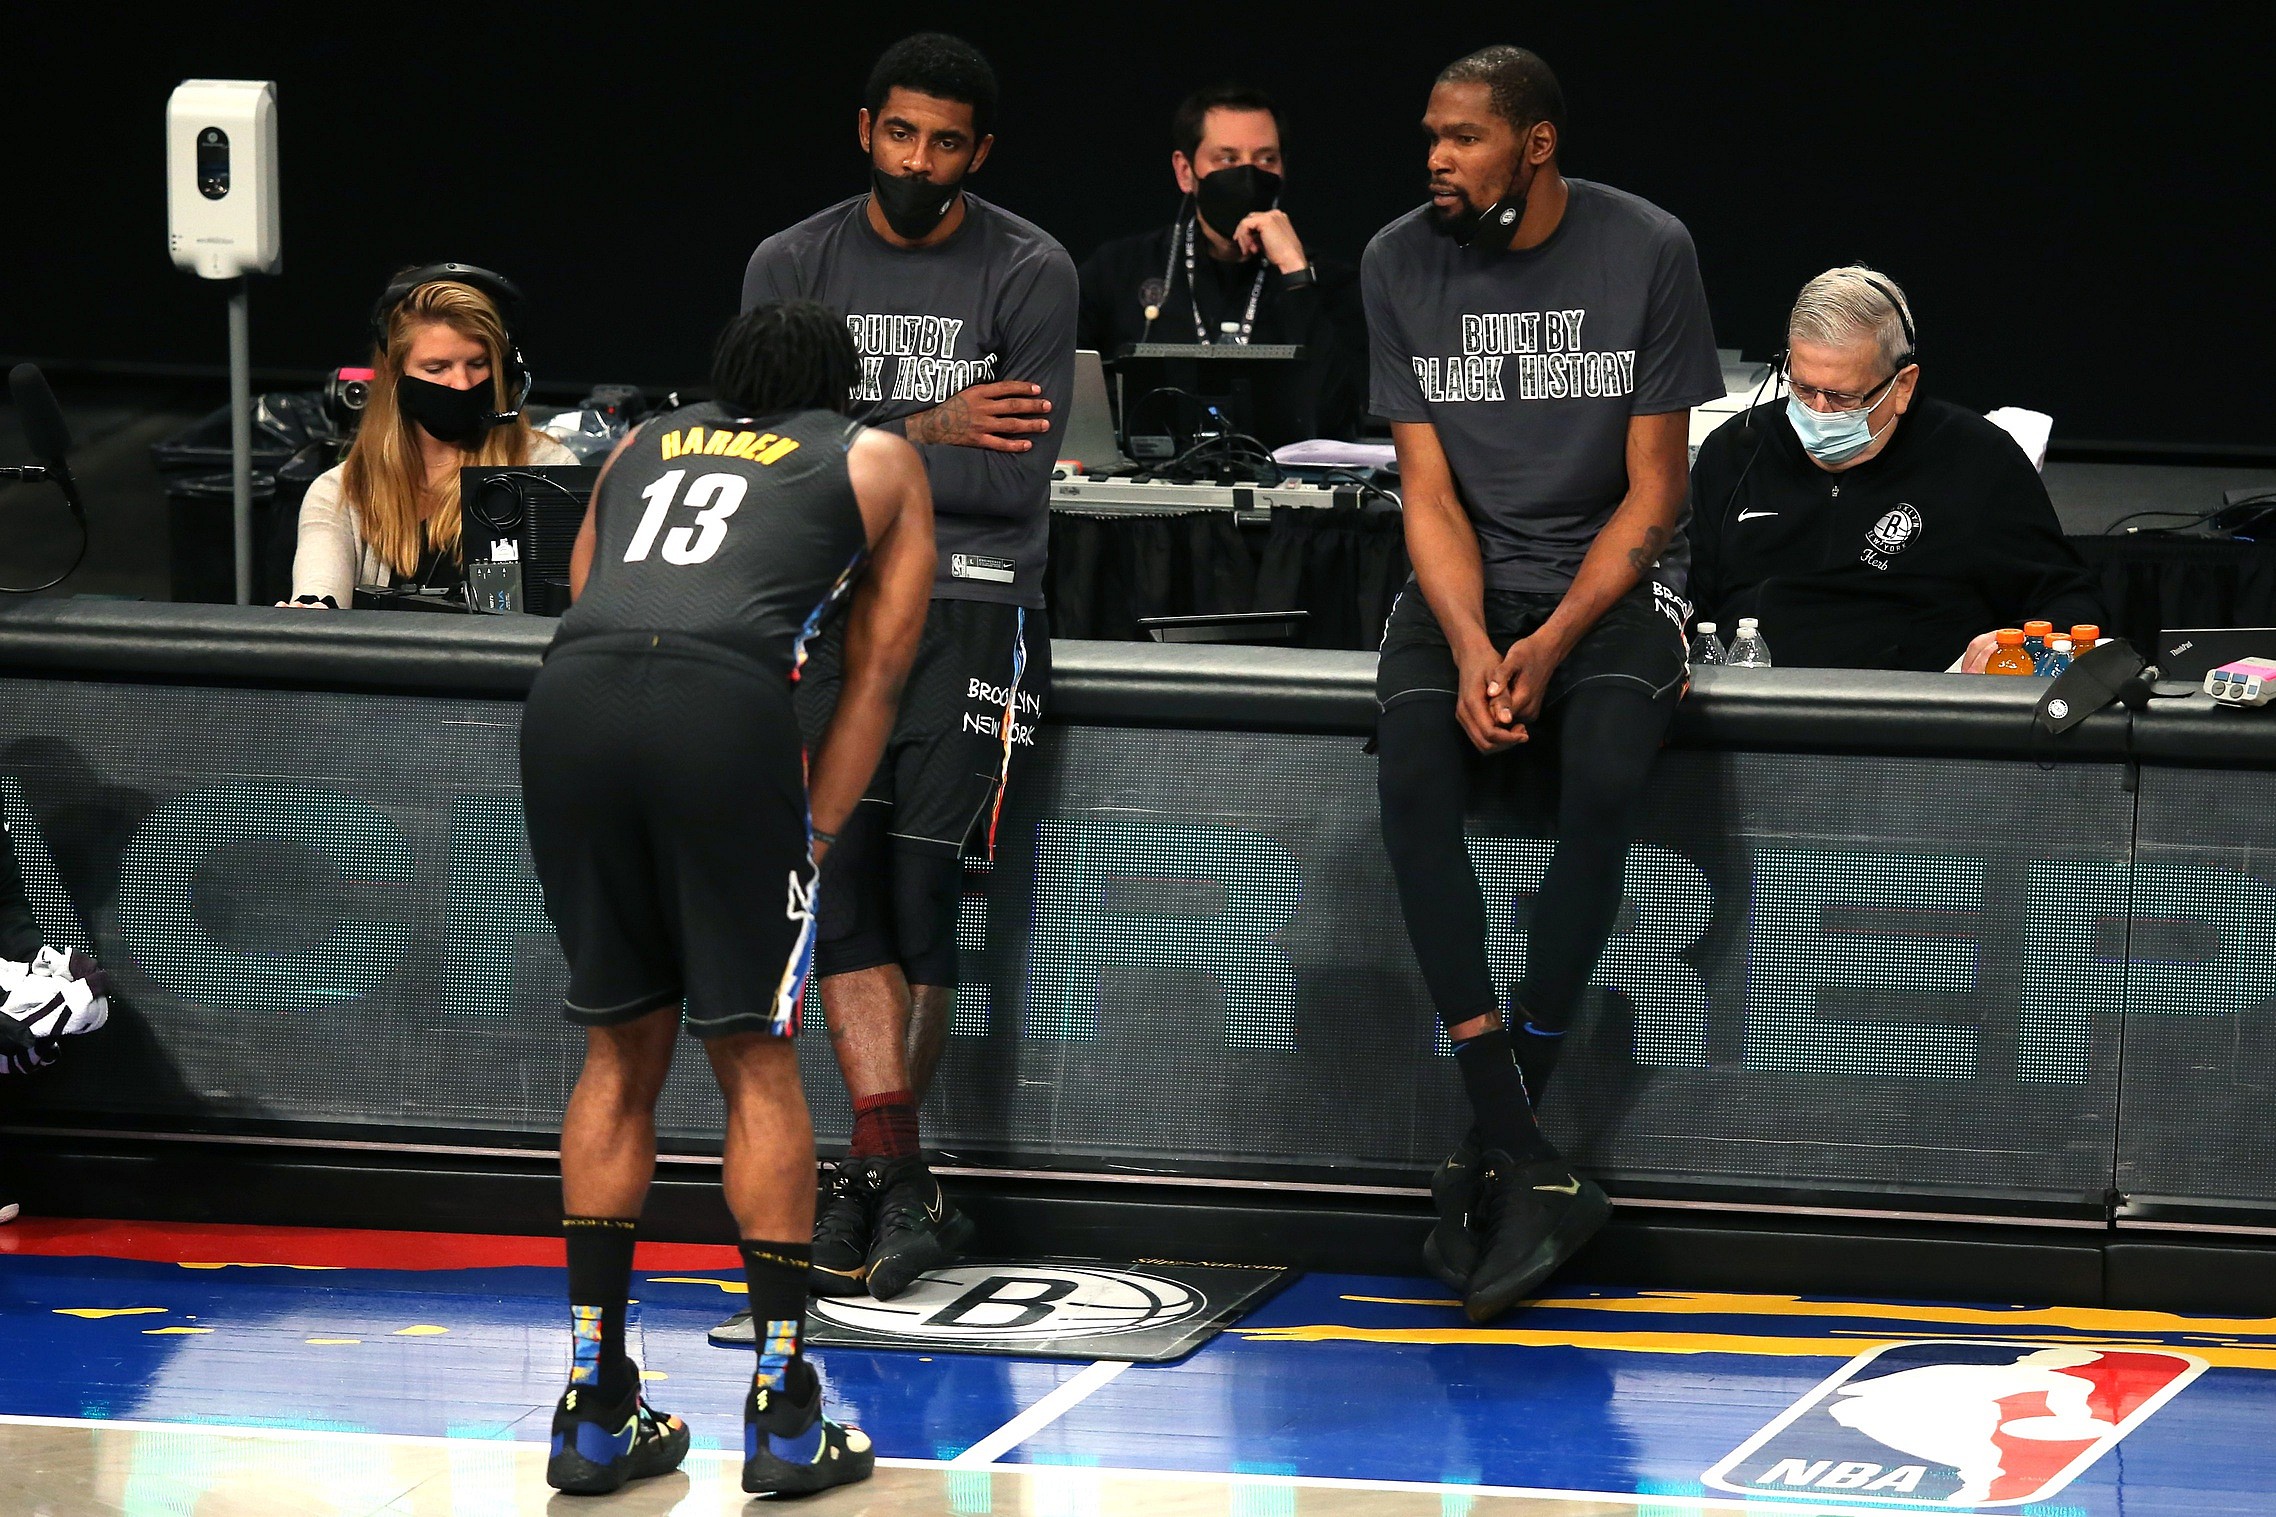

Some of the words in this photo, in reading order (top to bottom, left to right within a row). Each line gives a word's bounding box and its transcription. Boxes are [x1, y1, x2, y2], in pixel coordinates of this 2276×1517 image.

[847, 314, 921, 356] BUILT
[919, 315, 963, 359] BY
[1462, 312, 1540, 355] BUILT
[1546, 309, 1585, 353] BY
[1412, 356, 1505, 403] BLACK
[1519, 350, 1636, 400] HISTORY
[661, 427, 800, 466] HARDEN
[623, 469, 748, 566] 13
[1860, 548, 1889, 571] Herb
[967, 677, 1041, 719] BROOLYN,
[1008, 722, 1036, 747] ORK
[920, 1275, 1079, 1329] B
[1755, 1457, 1928, 1493] NBA
